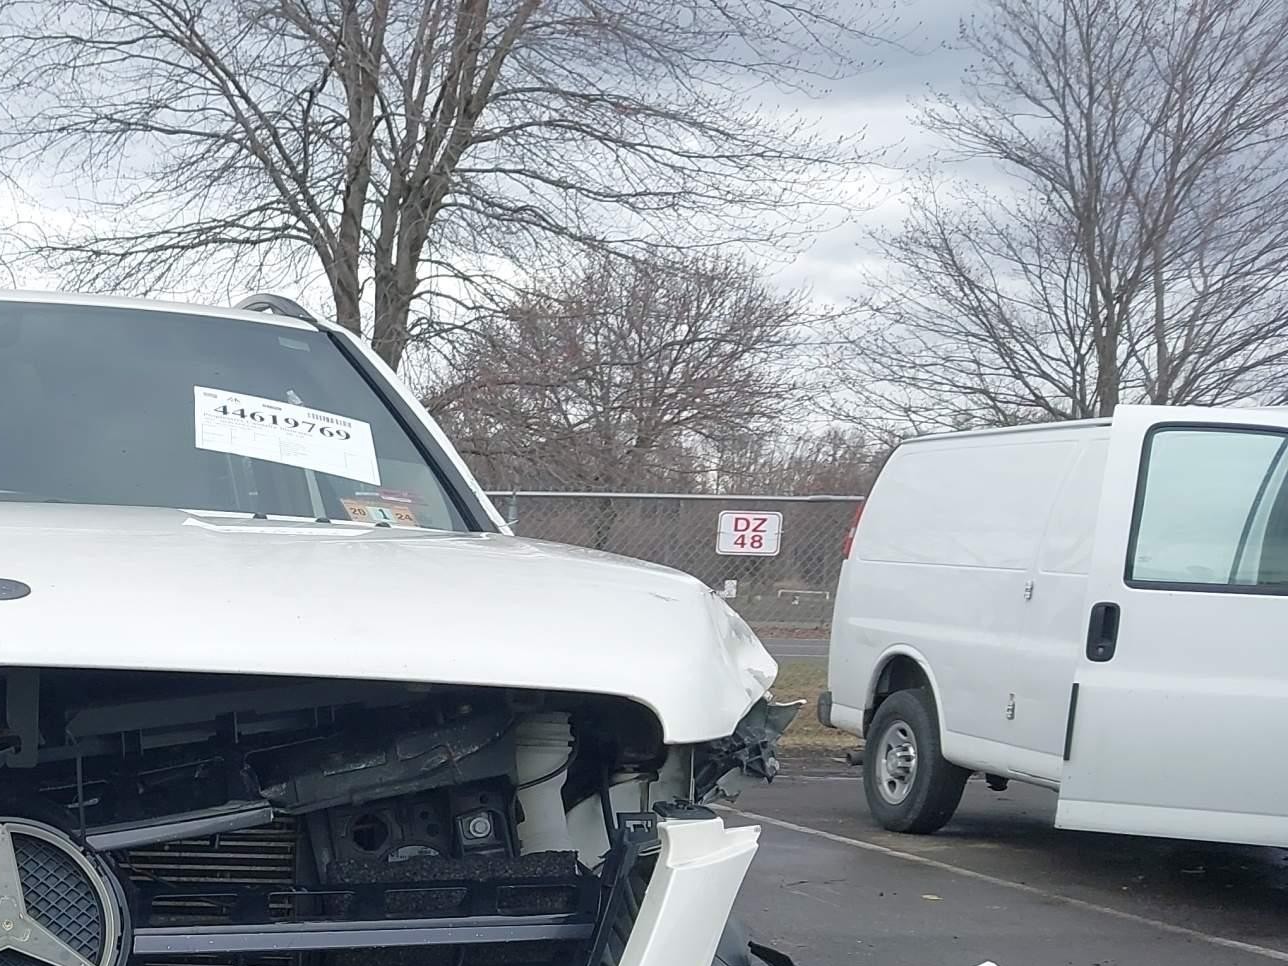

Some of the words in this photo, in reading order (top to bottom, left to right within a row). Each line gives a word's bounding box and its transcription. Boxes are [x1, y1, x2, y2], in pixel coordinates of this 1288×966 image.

[213, 405, 352, 441] 44619769
[350, 506, 367, 517] 20
[394, 512, 414, 521] 24
[733, 517, 769, 533] DZ
[733, 534, 764, 549] 48
